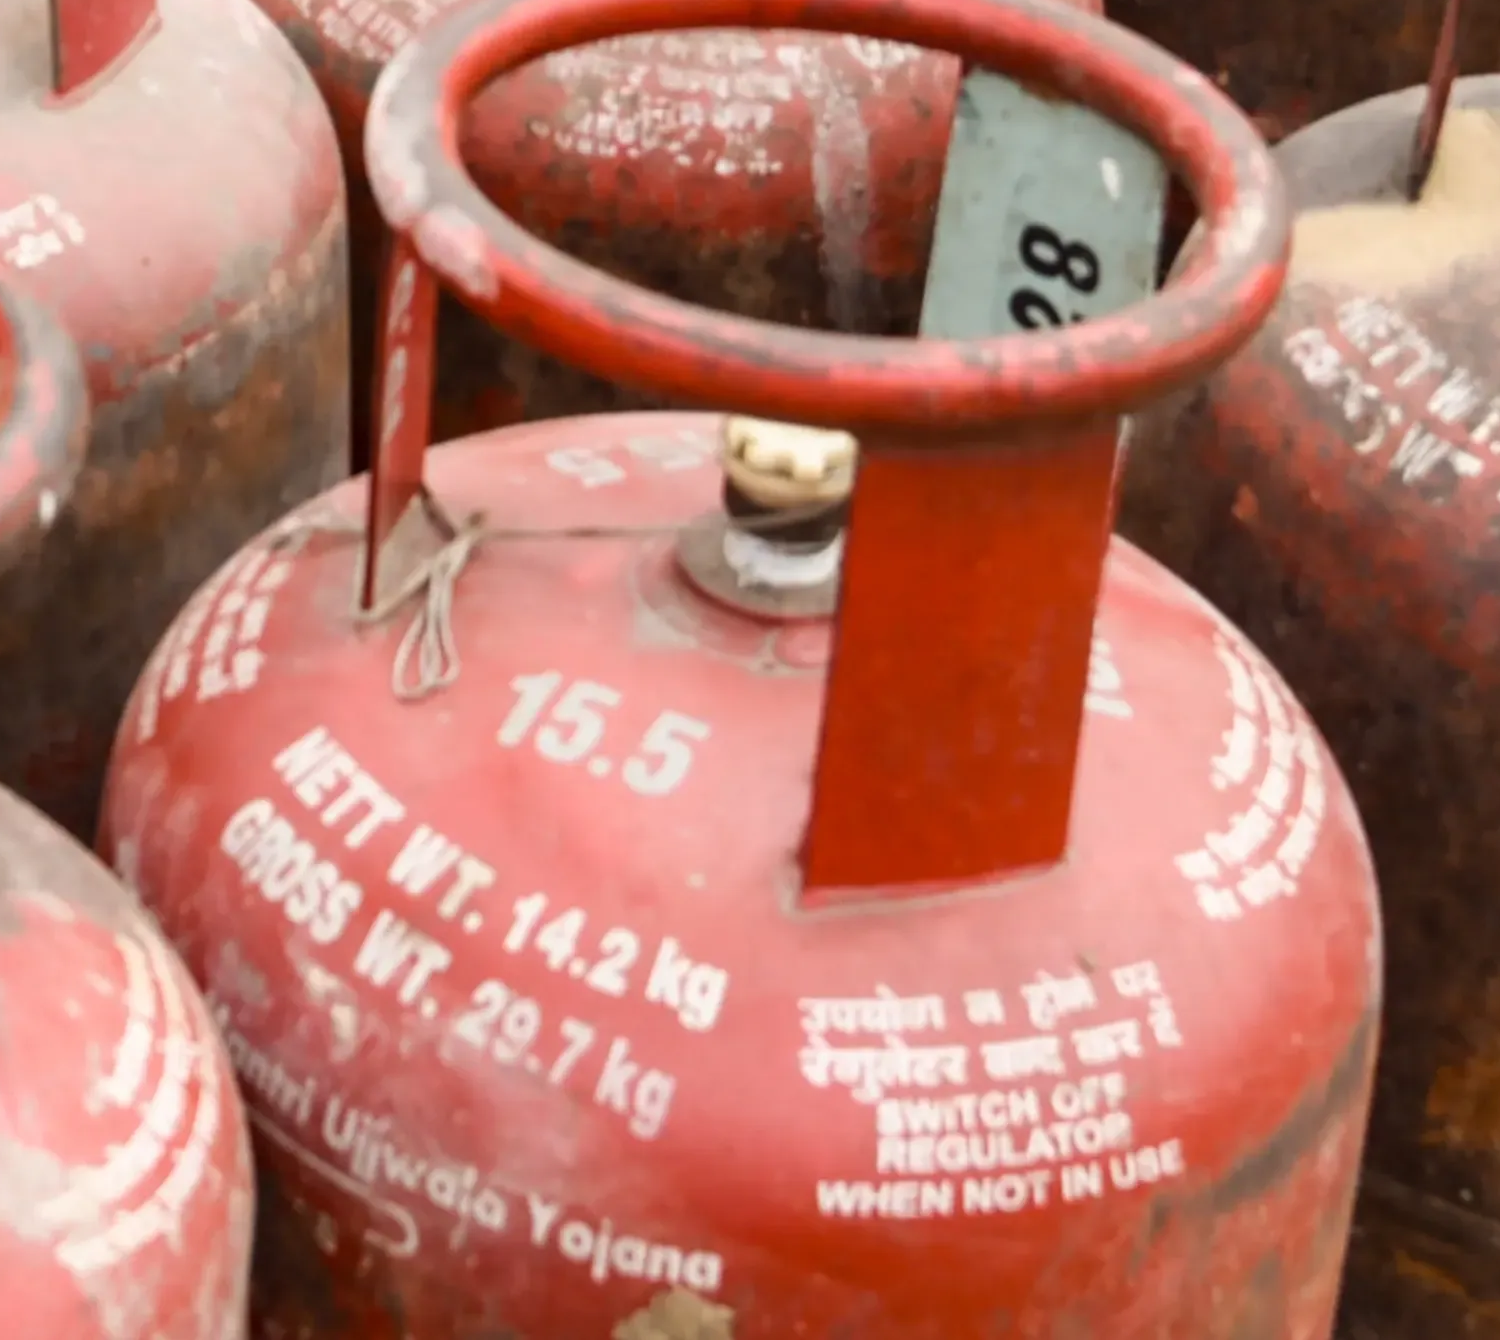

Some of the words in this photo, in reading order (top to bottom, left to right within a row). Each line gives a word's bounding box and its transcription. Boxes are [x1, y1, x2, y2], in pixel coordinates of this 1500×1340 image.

[492, 670, 711, 800] 15.5
[270, 724, 405, 848] NETT
[387, 819, 499, 934] WT.
[503, 891, 642, 999] 14.2
[643, 935, 732, 1034] kg
[219, 795, 363, 945] GROSS
[351, 906, 455, 1020] WT.
[453, 976, 596, 1086] 29.7
[592, 1035, 678, 1142] kg
[796, 980, 947, 1034] उपयोग
[962, 987, 1006, 1026] न
[875, 1084, 1041, 1140] SWITCH
[1048, 1070, 1126, 1122] OFF
[875, 1110, 1135, 1176] REGULATOR
[320, 1096, 511, 1231] Ujjwala
[524, 1191, 725, 1295] Yojana
[814, 1177, 956, 1219] WHEN
[961, 1168, 1054, 1215] NOT
[1058, 1158, 1106, 1203] IN
[1107, 1136, 1186, 1193] USE
